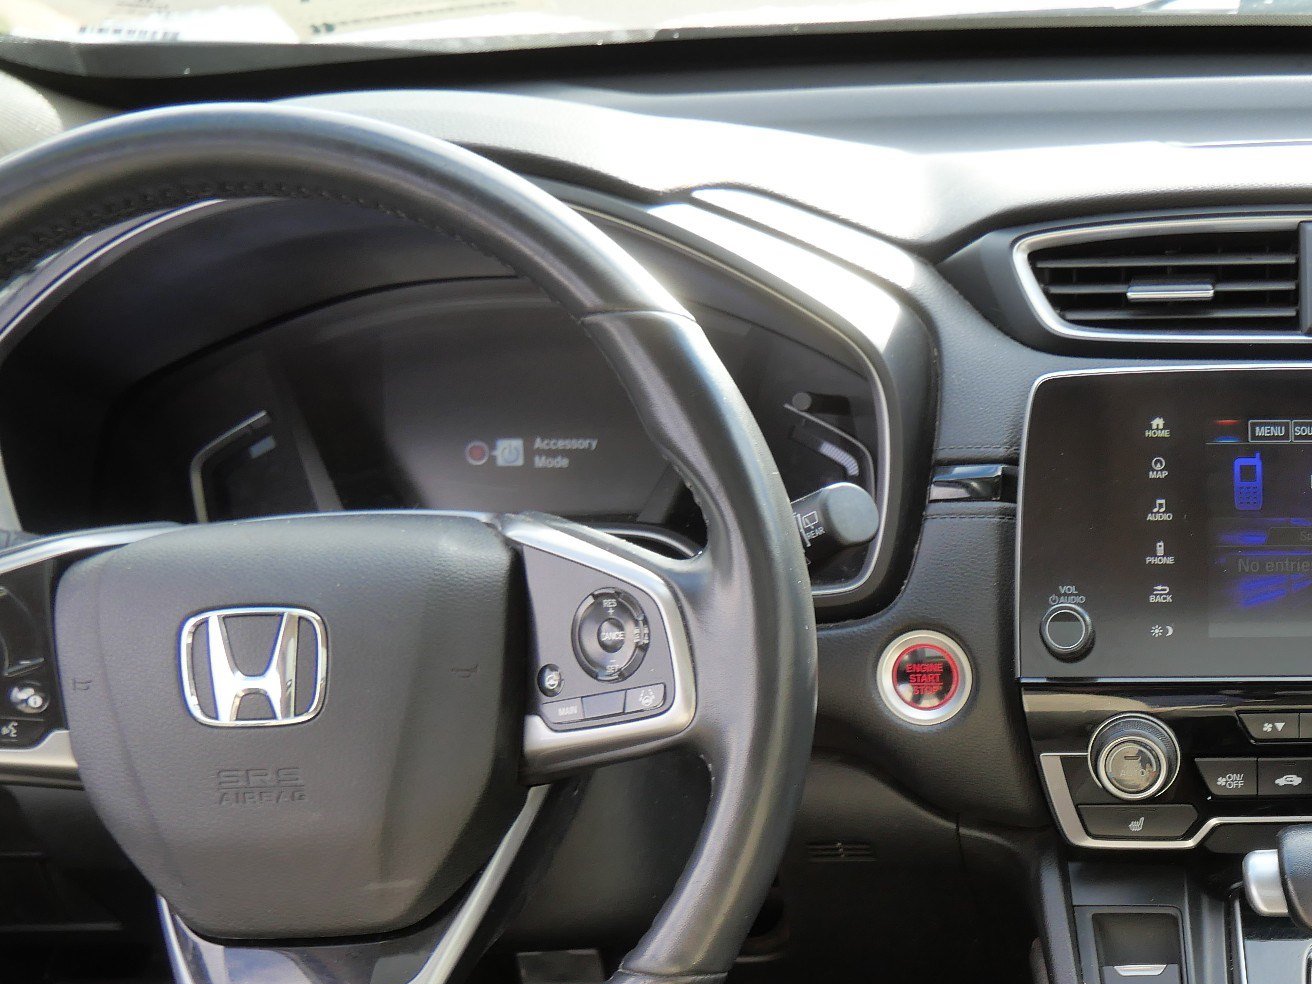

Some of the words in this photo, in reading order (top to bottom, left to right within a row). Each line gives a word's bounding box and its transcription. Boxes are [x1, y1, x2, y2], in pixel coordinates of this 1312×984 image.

[1145, 429, 1171, 438] HOME
[1255, 426, 1285, 436] MENU
[534, 436, 598, 450] Accessory
[534, 454, 570, 468] Mode
[1149, 471, 1169, 479] MAP
[1146, 513, 1173, 521] AUDIO
[1145, 557, 1175, 565] PHONE
[1237, 558, 1260, 573] No
[1058, 585, 1079, 594] VOL
[1058, 596, 1086, 604] AUDIO
[1148, 594, 1173, 603] BACK
[906, 662, 943, 672] ENGINE
[909, 674, 941, 683] START
[913, 685, 941, 695] STOP
[1226, 781, 1245, 789] OFF
